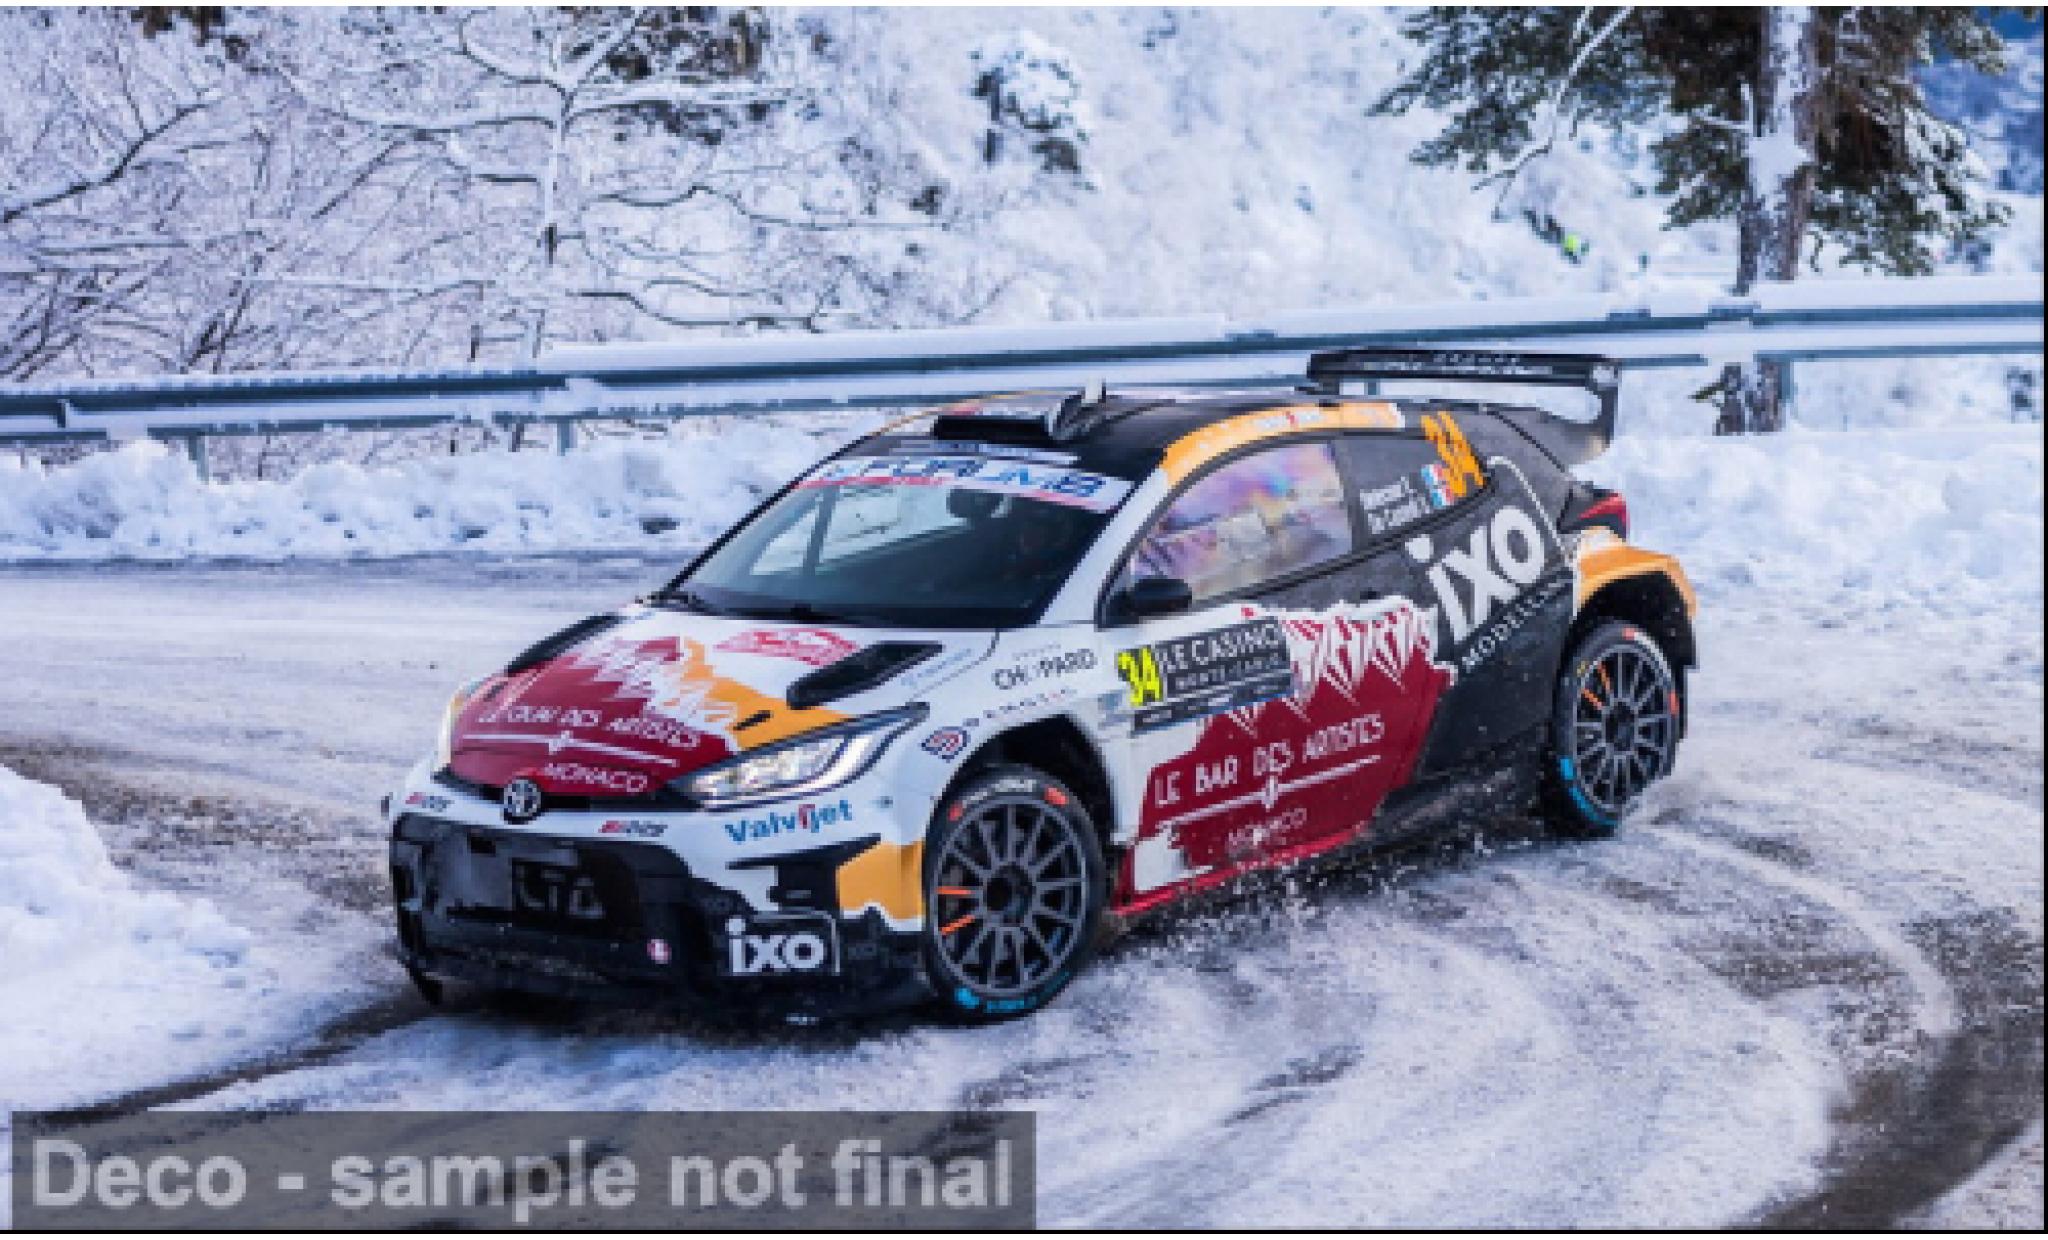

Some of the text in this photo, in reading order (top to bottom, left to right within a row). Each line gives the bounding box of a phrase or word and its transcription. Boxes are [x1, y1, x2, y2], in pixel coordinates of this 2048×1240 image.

[1421, 410, 1486, 497] 34
[1405, 505, 1545, 642] ixo
[1118, 647, 1163, 707] 34
[1162, 625, 1281, 674] LE CASINO
[542, 762, 648, 793] MONACO
[1154, 713, 1385, 807] LE BAR DES ARTISTES
[725, 916, 825, 974] ixo
